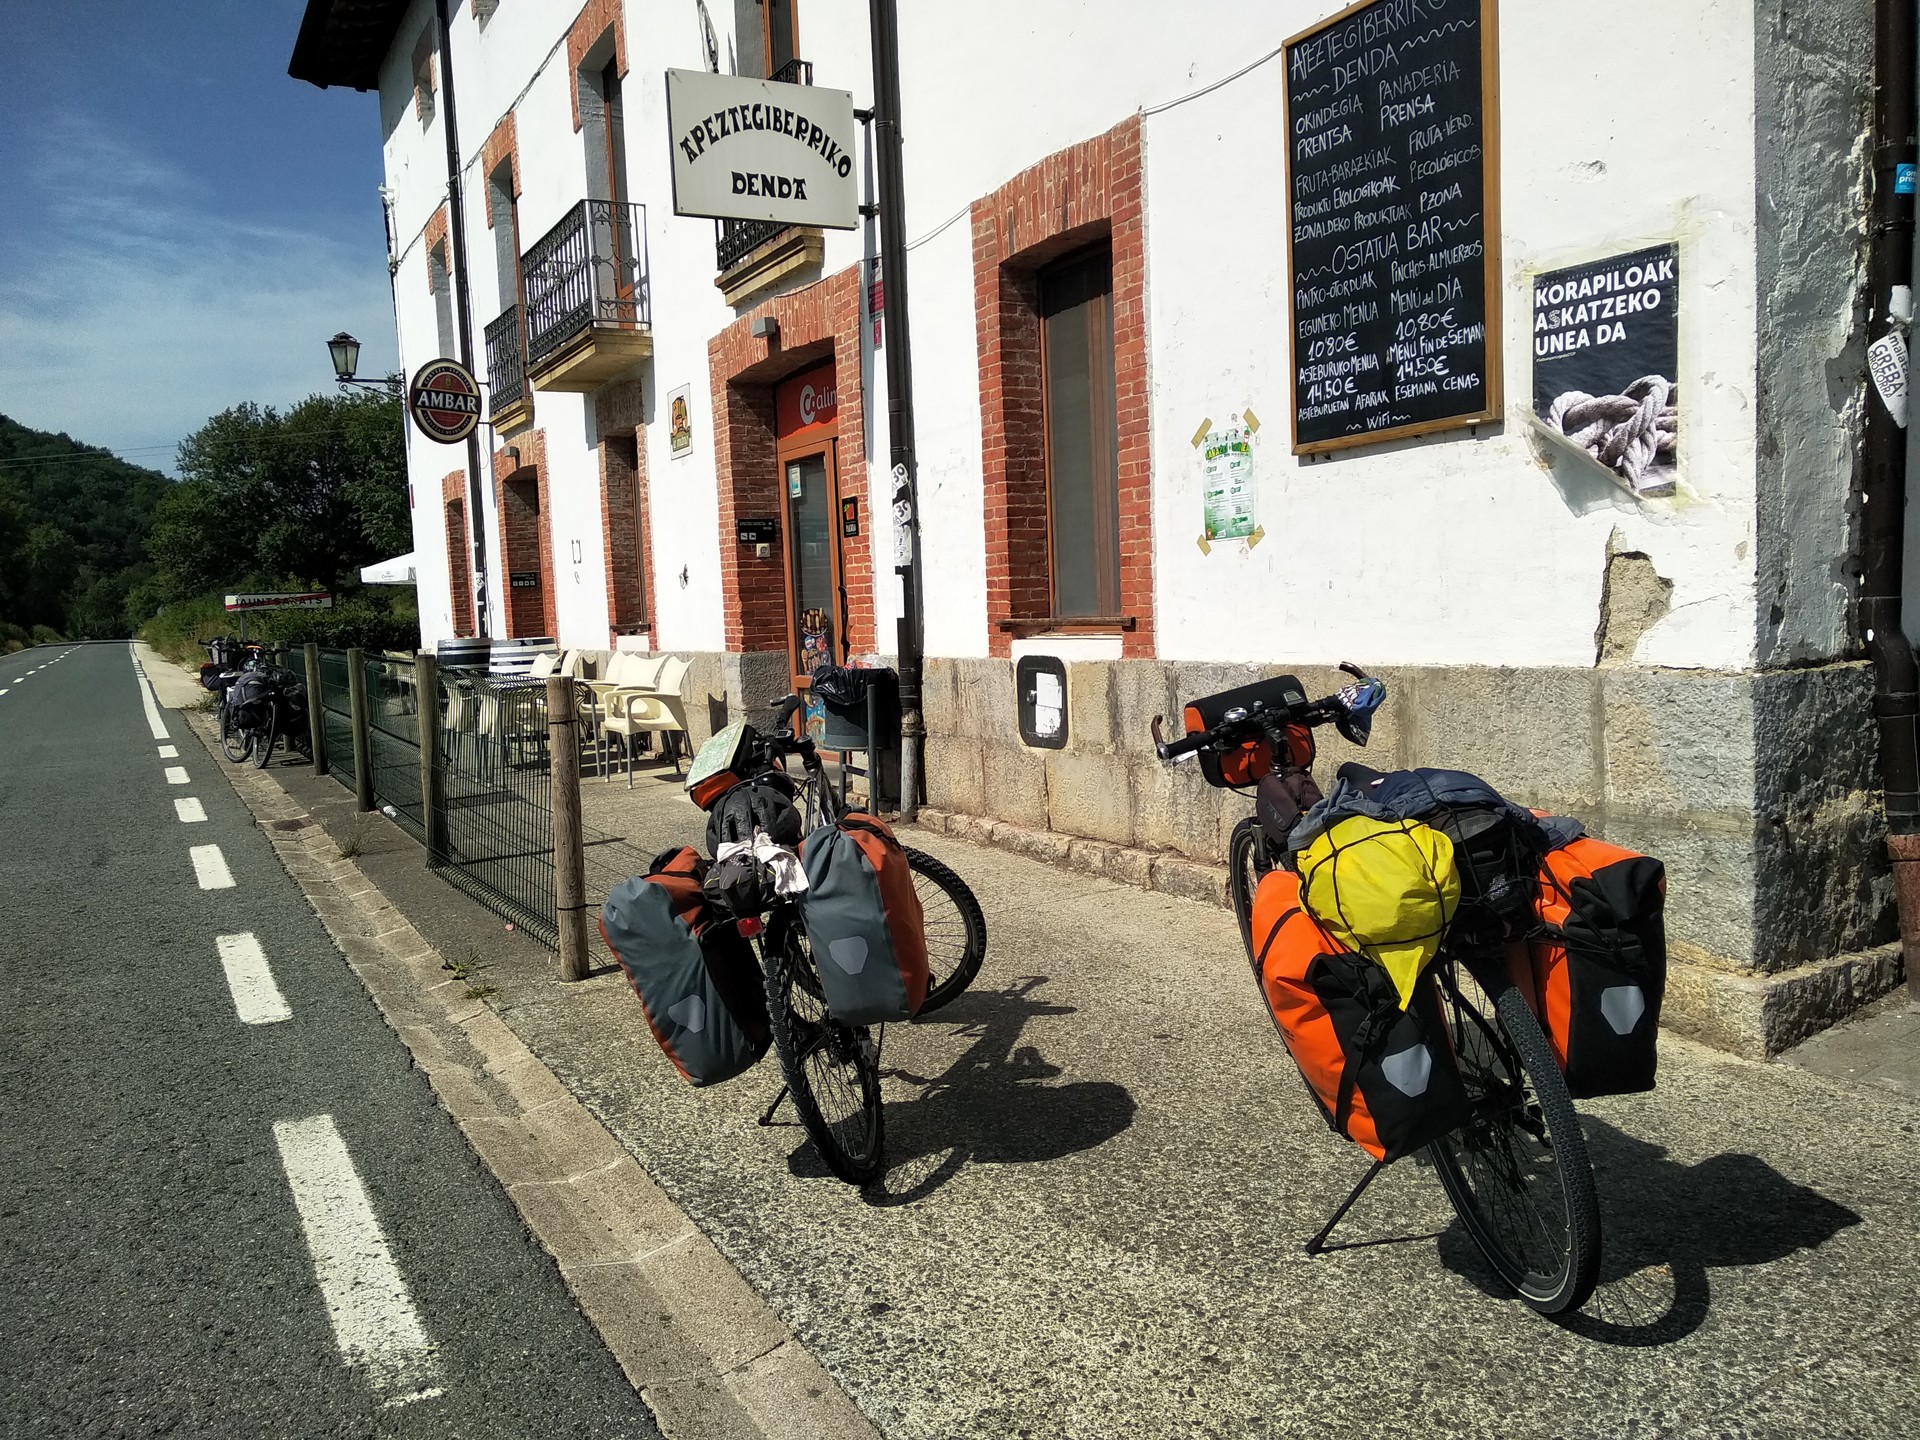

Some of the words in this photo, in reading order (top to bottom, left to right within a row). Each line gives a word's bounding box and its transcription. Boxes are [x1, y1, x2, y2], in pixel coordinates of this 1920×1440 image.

[1331, 43, 1400, 95] DENDA
[1296, 94, 1364, 134] OKINDEGIA
[1380, 94, 1436, 131] PRENSA
[679, 103, 852, 178] APEZTEGIBERRIKO
[1297, 124, 1353, 160] PRENTSA
[731, 171, 808, 200] DENDA
[1294, 198, 1332, 222] PRODUKTU
[1333, 176, 1401, 210] EKOLOGIKOAK
[1294, 217, 1351, 243] ZONALDEKO
[1354, 204, 1413, 232] PRODUKTUAK
[1331, 232, 1400, 275] OSTATUA
[1407, 215, 1443, 250] BAR
[1390, 287, 1421, 316] MENÚ
[1422, 290, 1434, 307] del
[1437, 274, 1464, 304] DÍA
[1535, 258, 1674, 309] KORAPILOAK
[1299, 312, 1342, 340] EGUNEKO
[1343, 301, 1380, 330] MENUA
[1535, 288, 1661, 332] ASKATZEKO
[1389, 341, 1417, 365] MENU
[1420, 335, 1435, 356] FIN
[1435, 336, 1448, 350] DE
[1447, 321, 1487, 345] SEMANA
[1535, 328, 1591, 356] UNEA
[1597, 321, 1627, 345] DA
[1299, 360, 1350, 386] ASTEBURUKO
[1350, 353, 1380, 376] MENUA
[1442, 373, 1480, 391] CENAS
[1873, 344, 1904, 398] GREBA
[416, 390, 478, 412] AMBAR
[1298, 397, 1350, 421] ASTEBURUETAN
[1355, 390, 1390, 411] AFARIAK
